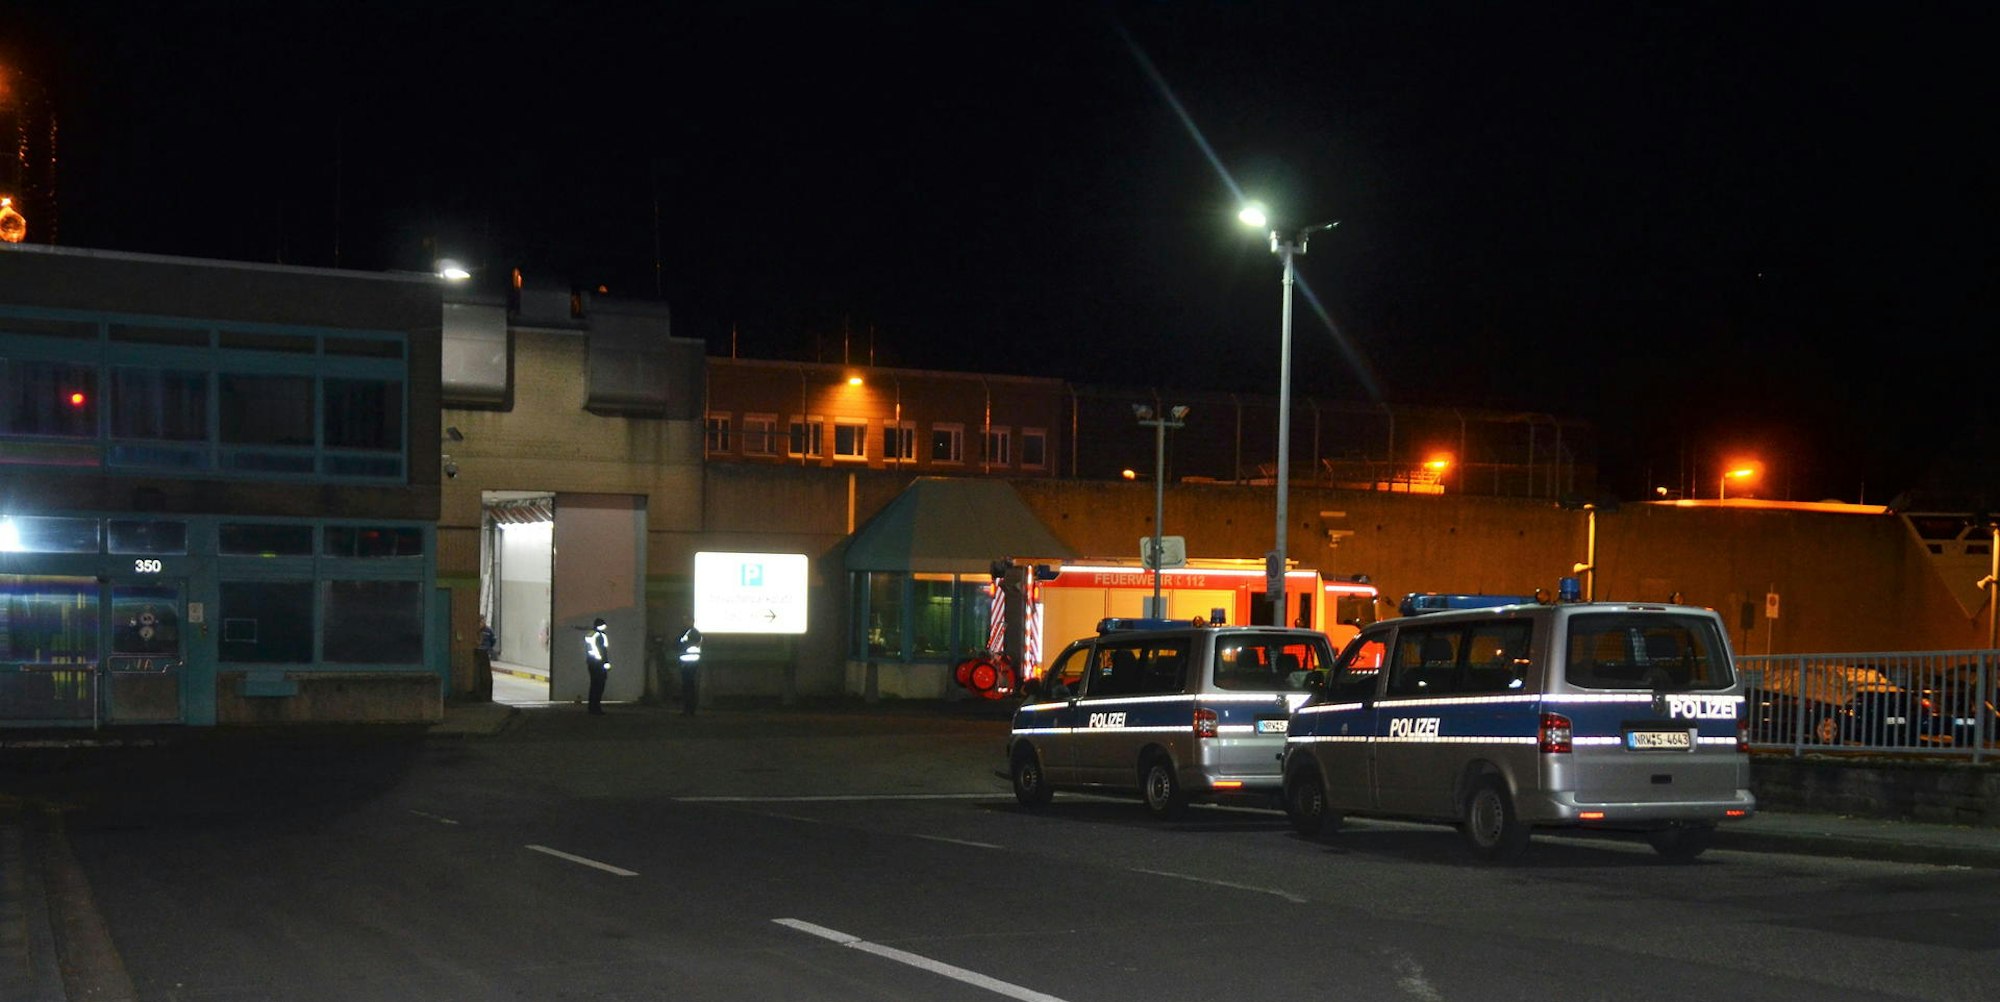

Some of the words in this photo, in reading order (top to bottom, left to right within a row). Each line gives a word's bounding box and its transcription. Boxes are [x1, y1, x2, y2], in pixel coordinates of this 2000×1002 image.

[135, 559, 162, 573] 350
[744, 564, 760, 586] P
[1186, 575, 1206, 587] 112
[1669, 698, 1737, 719] POLIZEI
[1089, 712, 1126, 728] POLIZEI
[1389, 717, 1440, 737] POLIZEI
